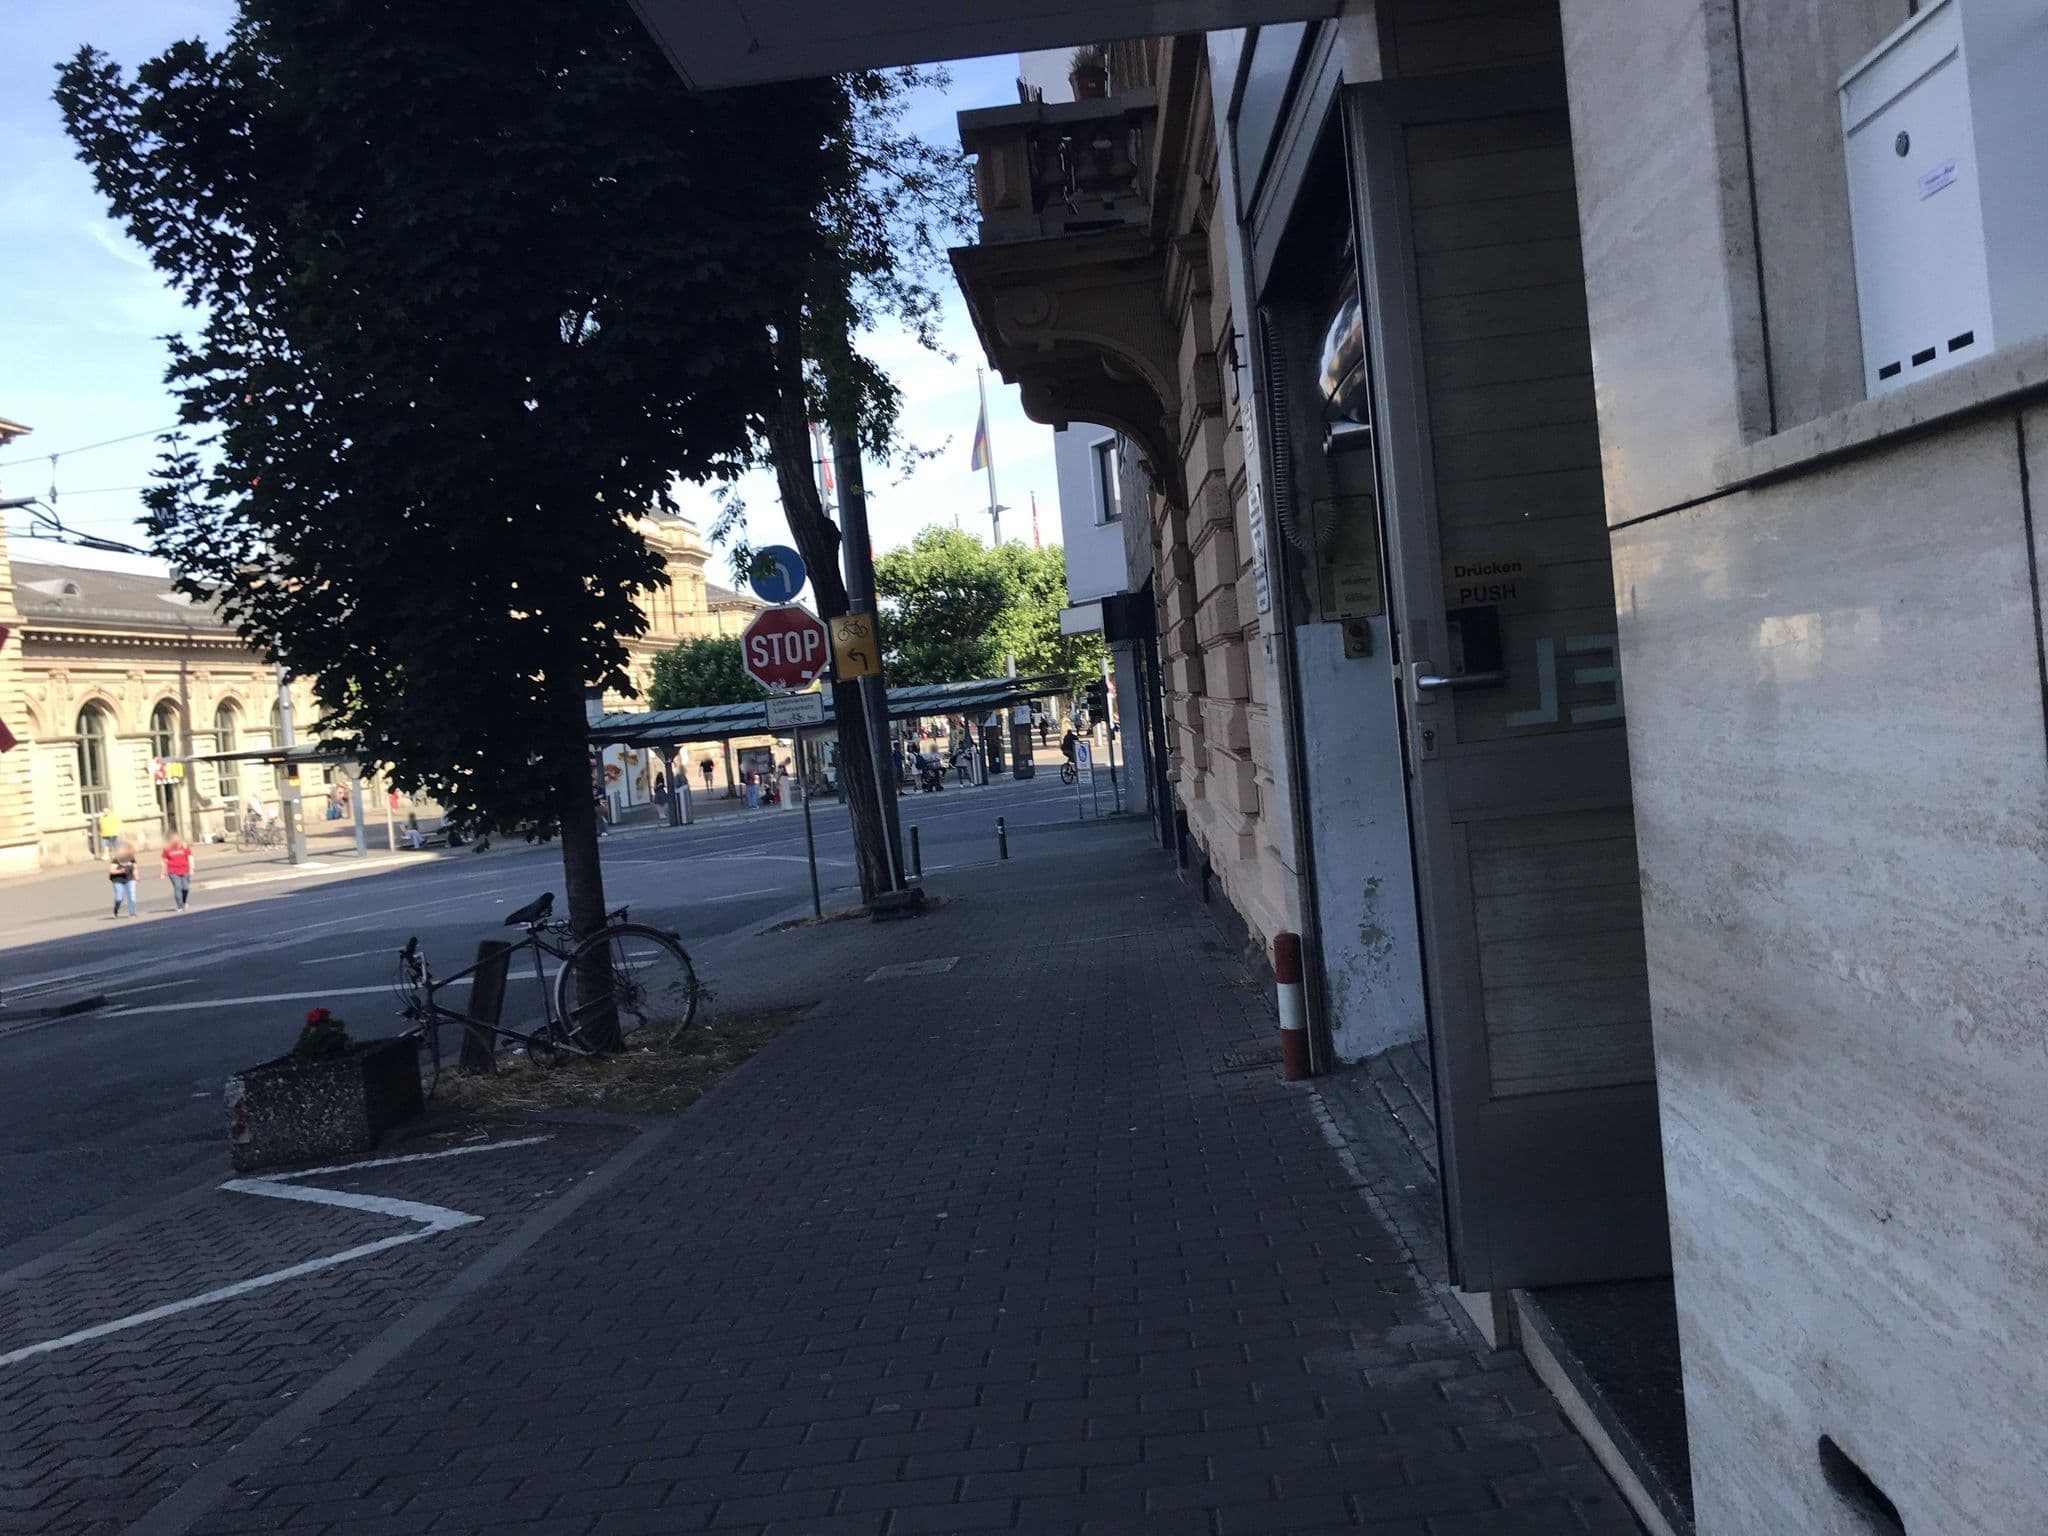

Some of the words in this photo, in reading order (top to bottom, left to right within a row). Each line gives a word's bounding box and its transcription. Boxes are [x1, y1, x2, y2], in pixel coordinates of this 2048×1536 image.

[1454, 562, 1522, 578] Drücken
[1460, 584, 1518, 604] PUSH
[751, 629, 820, 668] STOP
